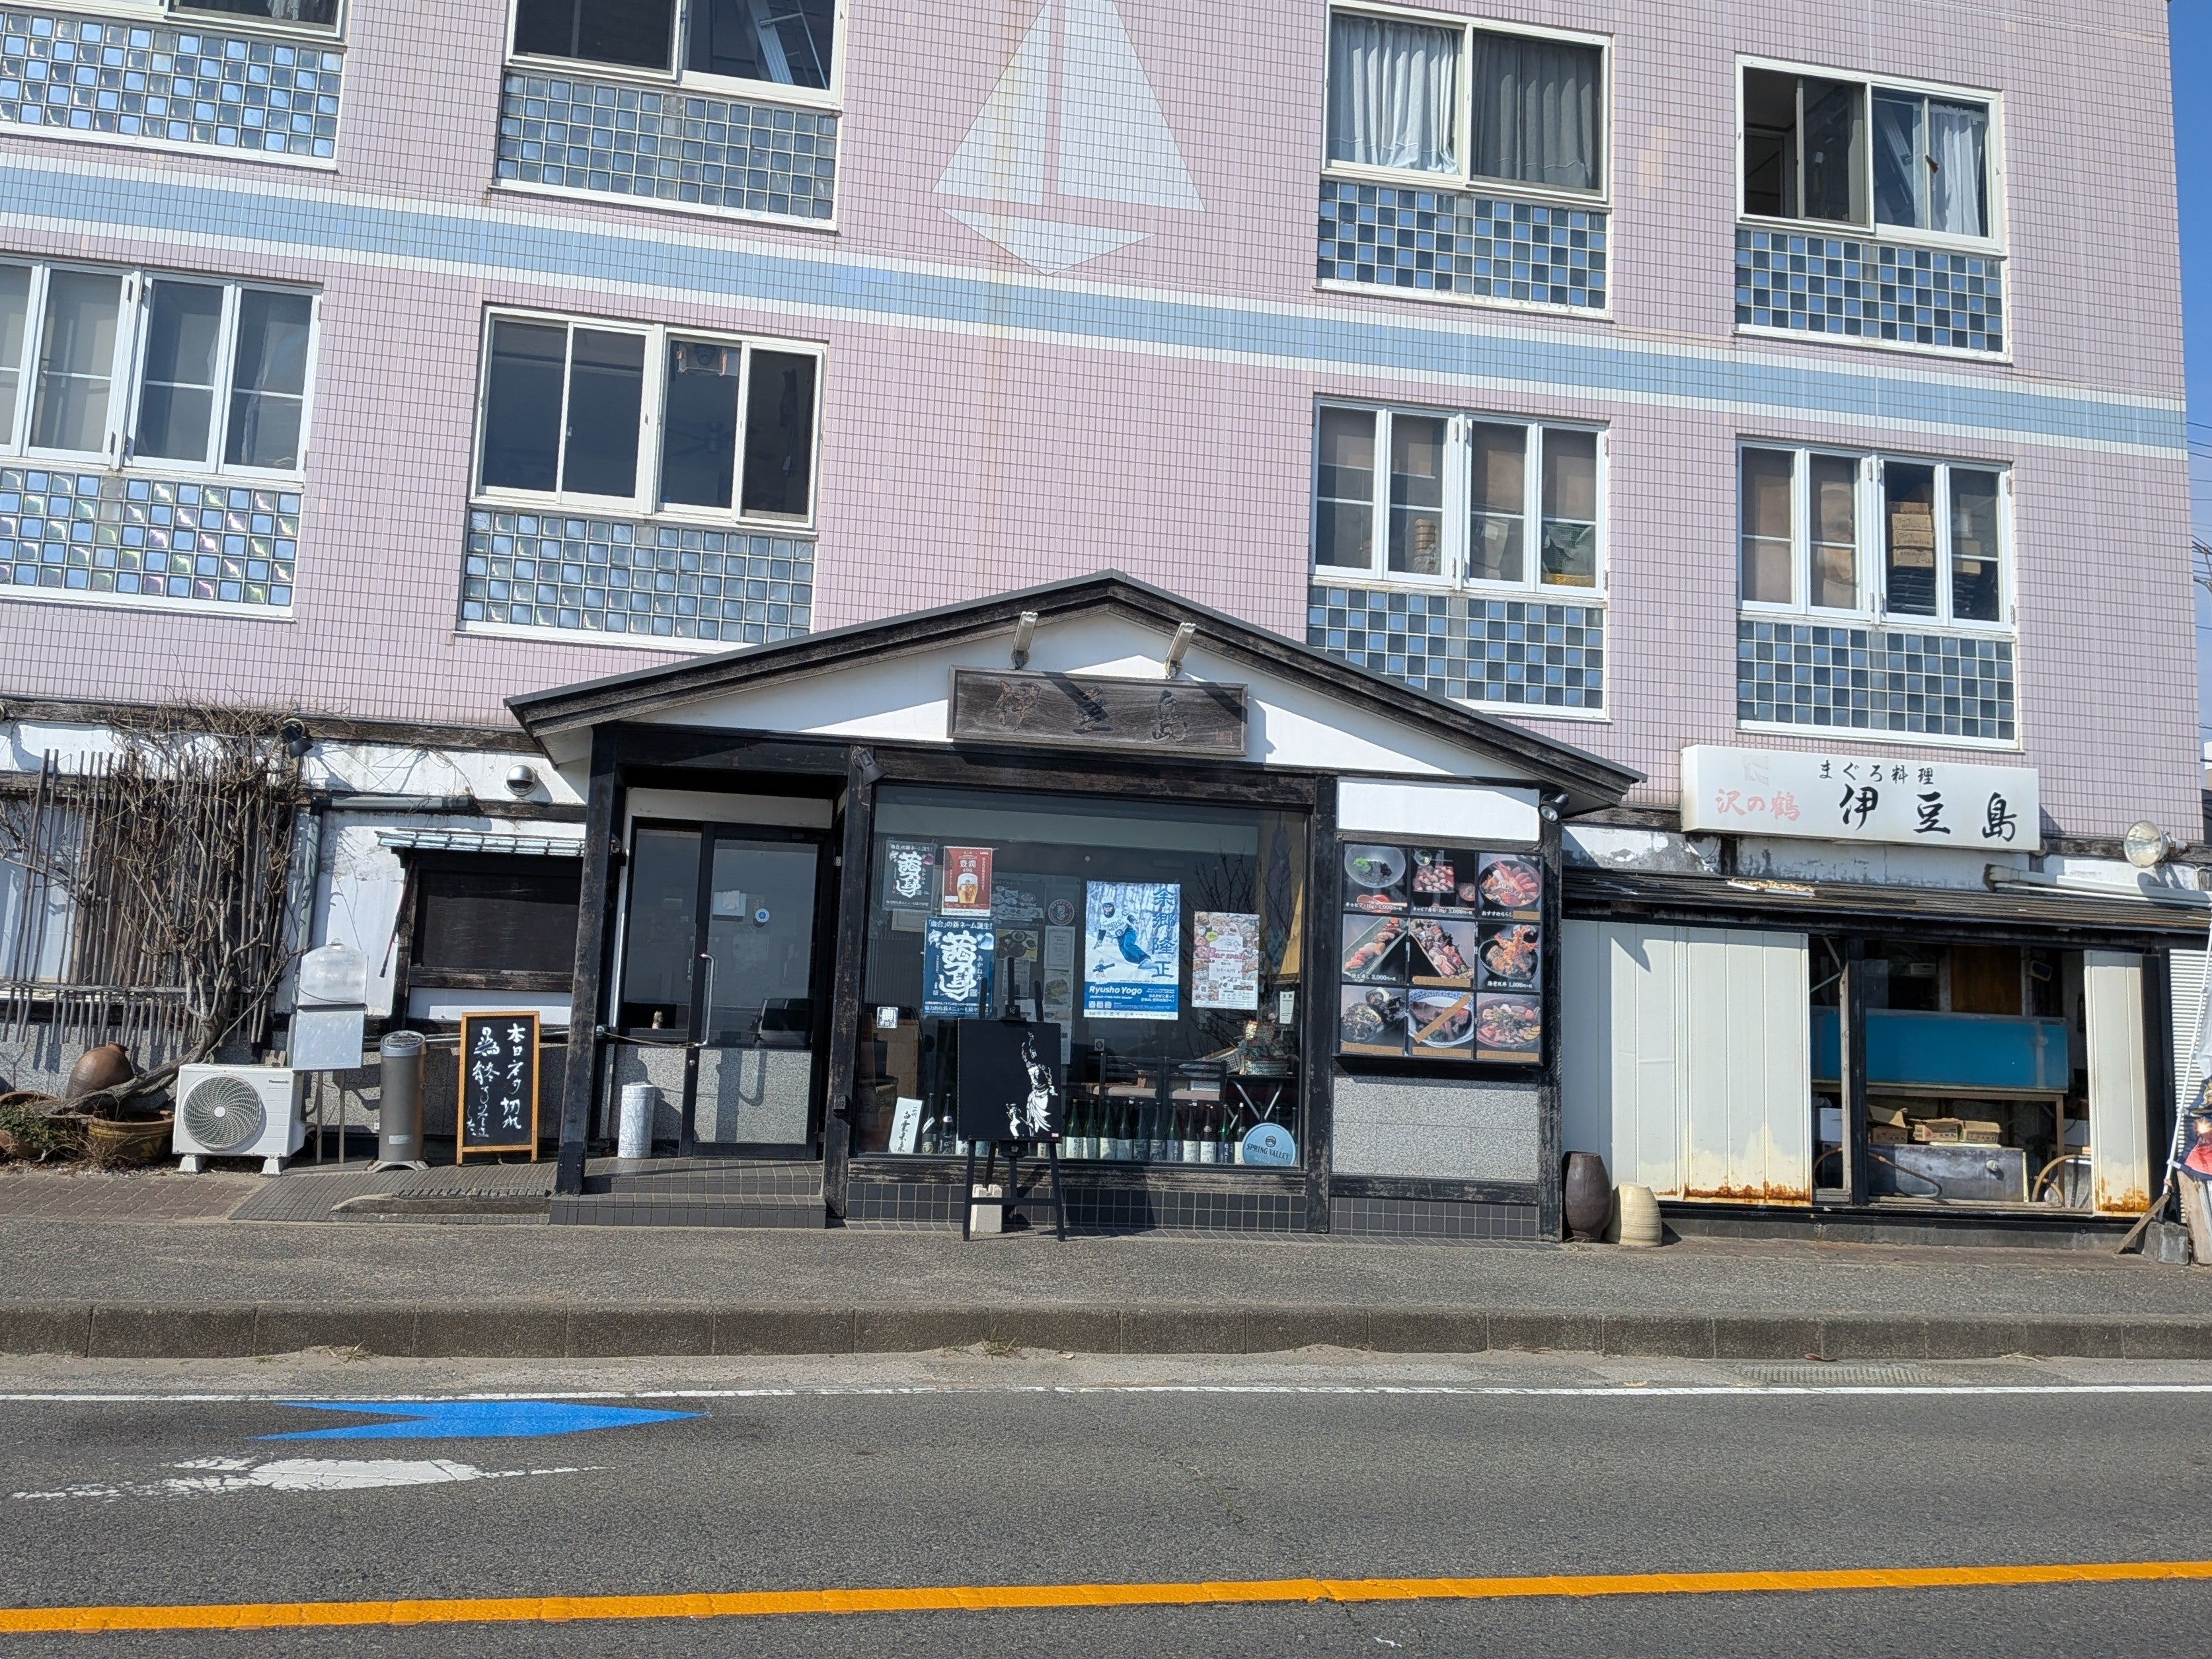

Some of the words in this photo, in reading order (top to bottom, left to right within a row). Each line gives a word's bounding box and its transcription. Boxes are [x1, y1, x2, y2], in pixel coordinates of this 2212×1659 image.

[1819, 760, 1934, 786] まぐろ料理
[1716, 788, 1800, 821] 沢の鶴
[1839, 784, 2017, 842] 伊豆島
[960, 860, 976, 868] 豊潤
[1151, 888, 1178, 978] 余郷隆正
[1089, 986, 1120, 995] Ryusho
[1121, 986, 1143, 996] Yogo
[500, 1023, 526, 1129] 本日ネタ切れ
[1246, 1142, 1268, 1155] SPRING
[1268, 1148, 1290, 1160] VALLEY
